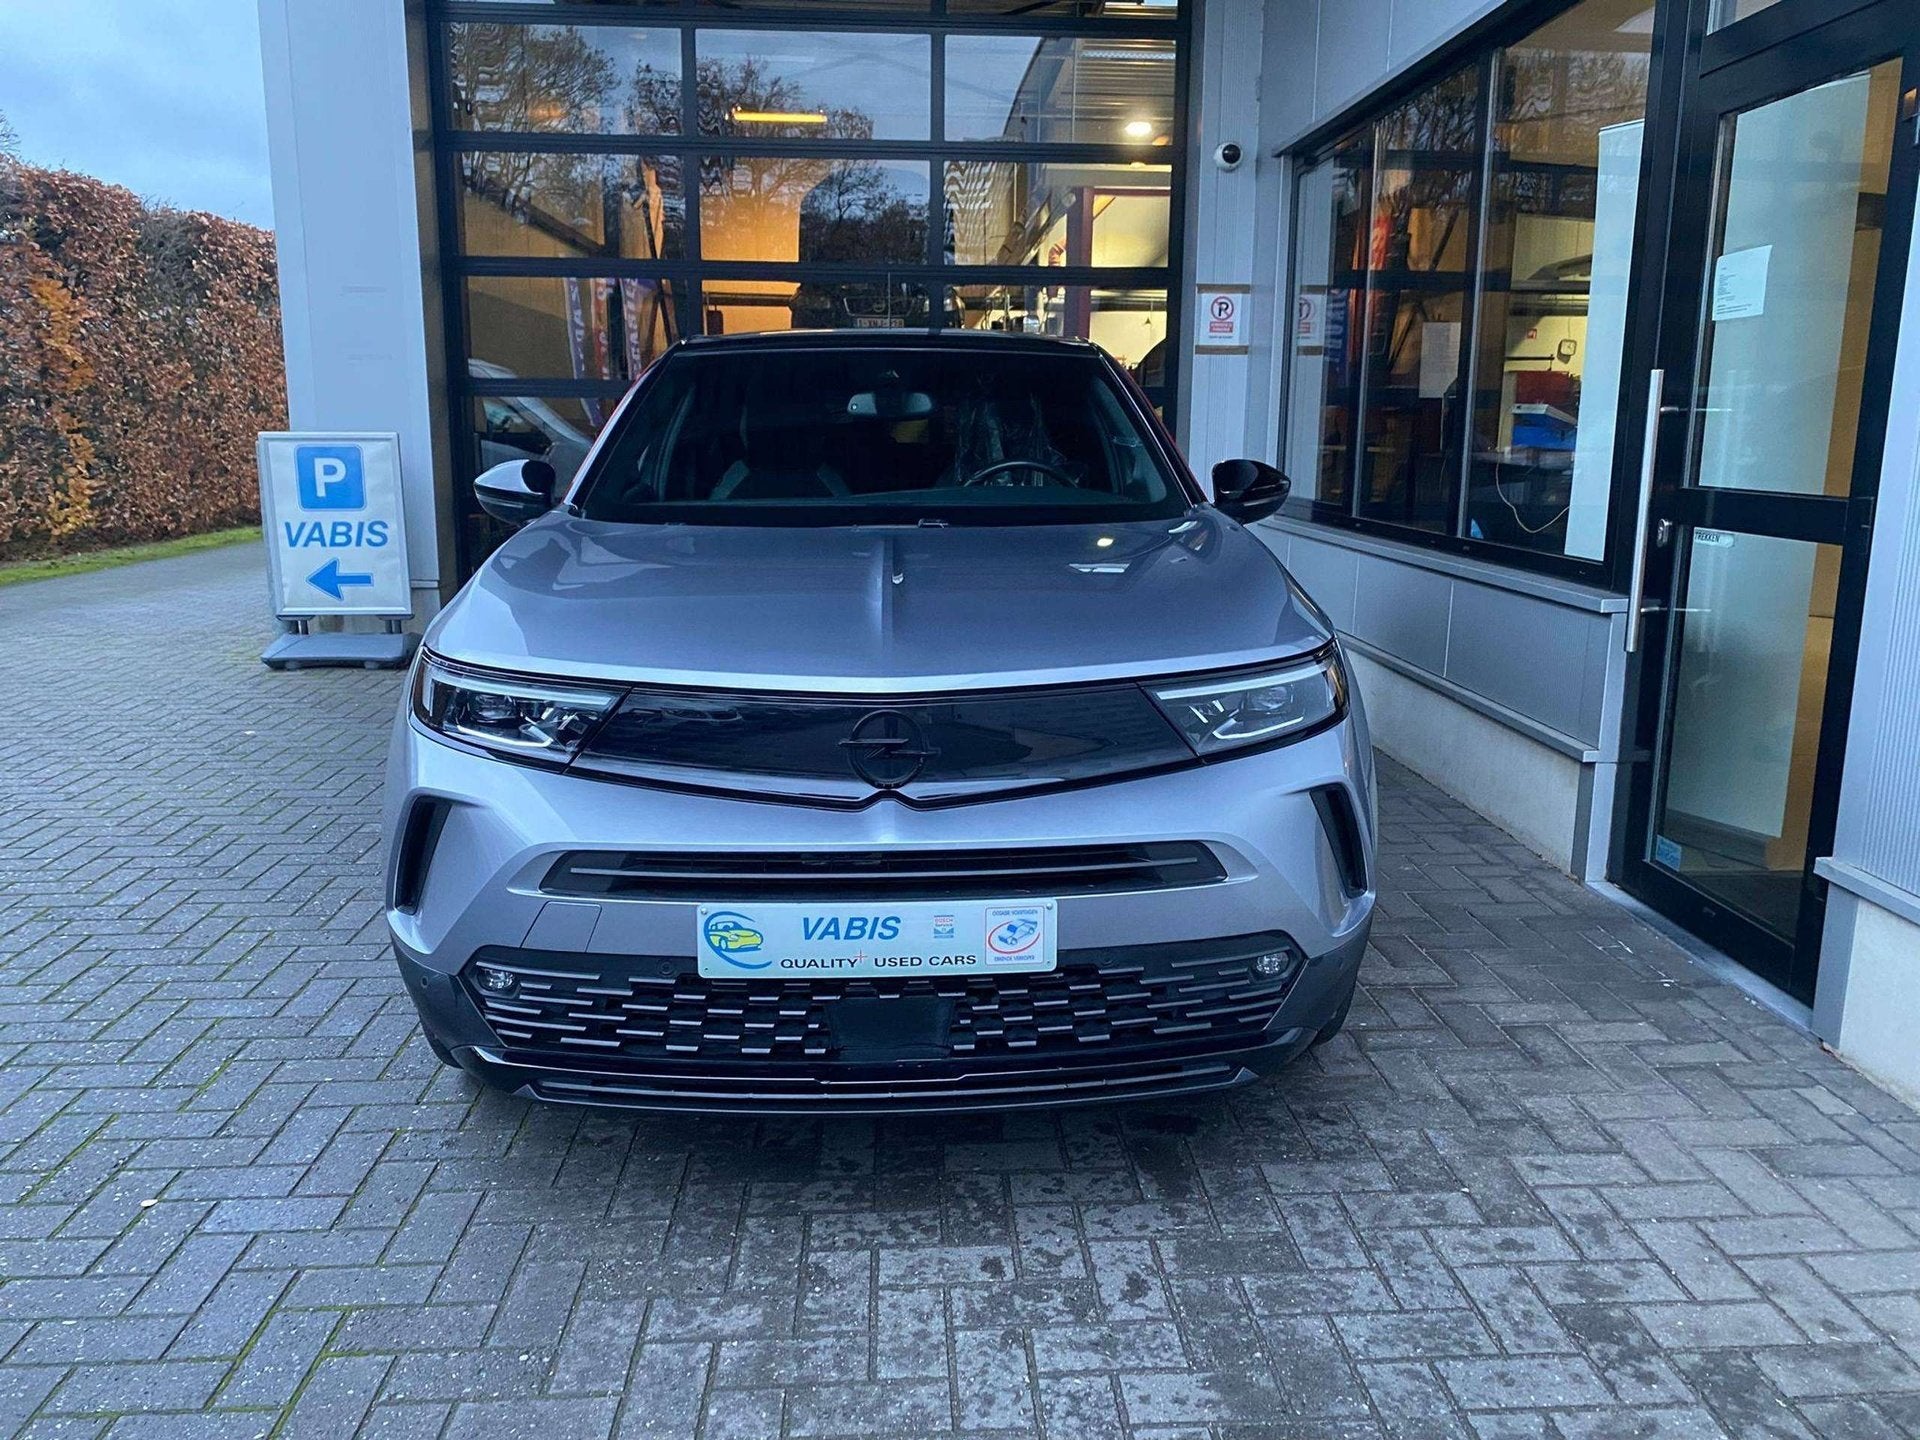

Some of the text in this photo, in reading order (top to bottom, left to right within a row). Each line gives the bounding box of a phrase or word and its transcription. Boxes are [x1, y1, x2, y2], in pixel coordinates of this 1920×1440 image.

[314, 458, 347, 497] P
[284, 521, 389, 548] VABIS
[803, 916, 901, 940] VABIS
[874, 956, 922, 967] USED
[929, 955, 976, 966] CARS
